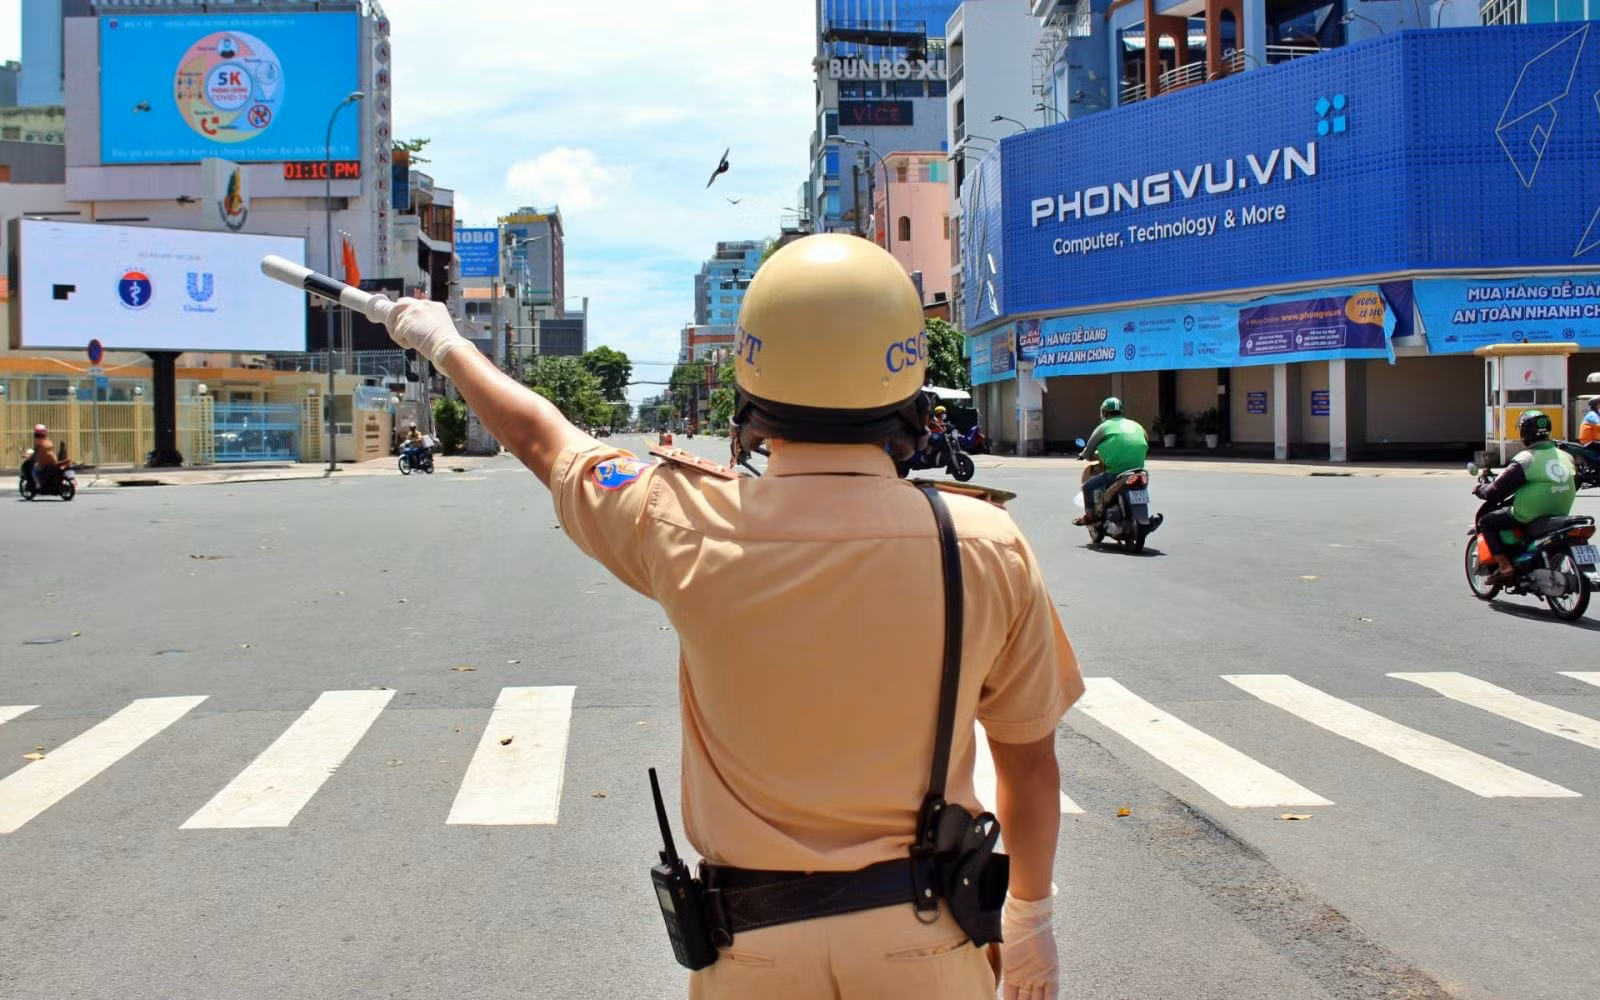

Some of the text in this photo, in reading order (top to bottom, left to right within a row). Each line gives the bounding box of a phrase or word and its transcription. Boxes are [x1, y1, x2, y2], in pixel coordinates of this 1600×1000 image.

[829, 53, 874, 80] BÚN
[880, 52, 911, 80] BÒ
[284, 162, 359, 178] 01:10 PM
[1031, 142, 1316, 227] PHONGVU.VN
[1053, 204, 1286, 255] Computer, Technology & More
[1467, 286, 1502, 301] MUA
[1505, 283, 1548, 300] HÀNG
[1551, 280, 1572, 298] DỄ
[1453, 309, 1476, 324] AN
[1479, 304, 1522, 322] TOÀN
[1525, 305, 1581, 320] NHANH
